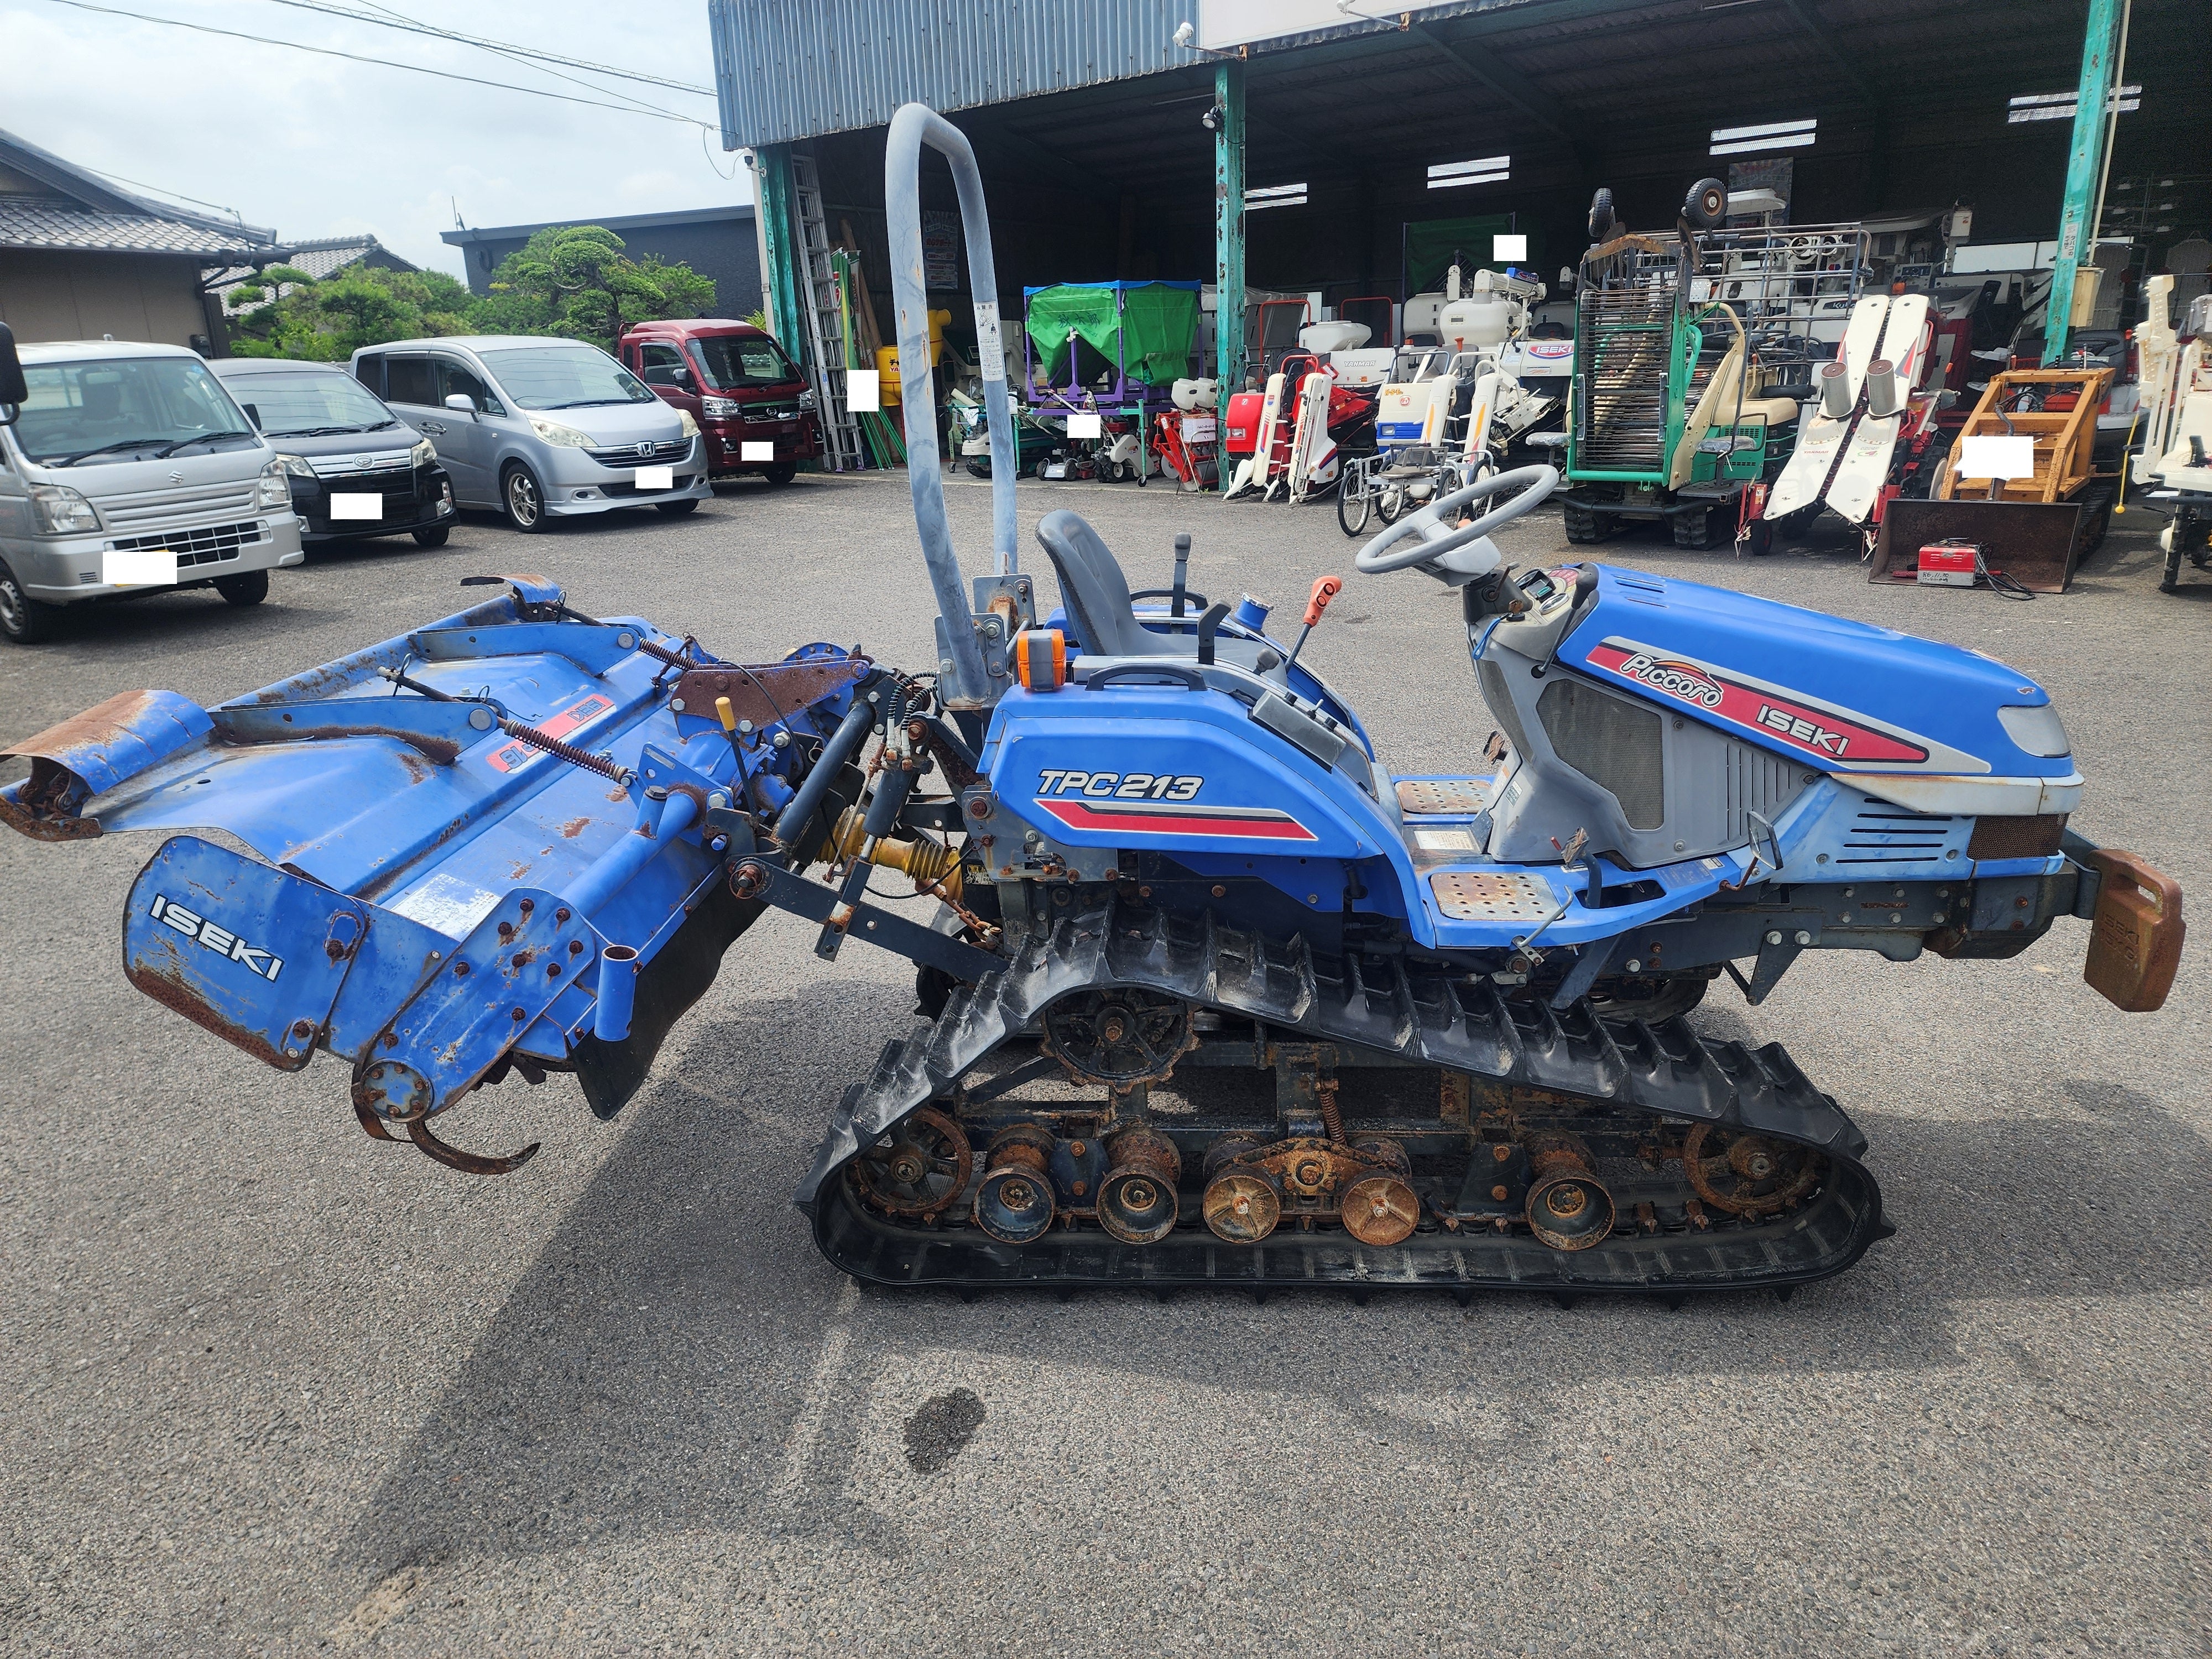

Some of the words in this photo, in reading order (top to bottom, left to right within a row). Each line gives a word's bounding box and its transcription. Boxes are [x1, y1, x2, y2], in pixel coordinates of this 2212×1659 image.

[1619, 653, 1724, 707] Piccoro
[567, 698, 606, 722] ISEKI
[1756, 703, 1850, 757] ISEKI
[1037, 769, 1204, 801] TPC213
[148, 893, 285, 983] ISEKI
[2100, 911, 2140, 945] ISEKI
